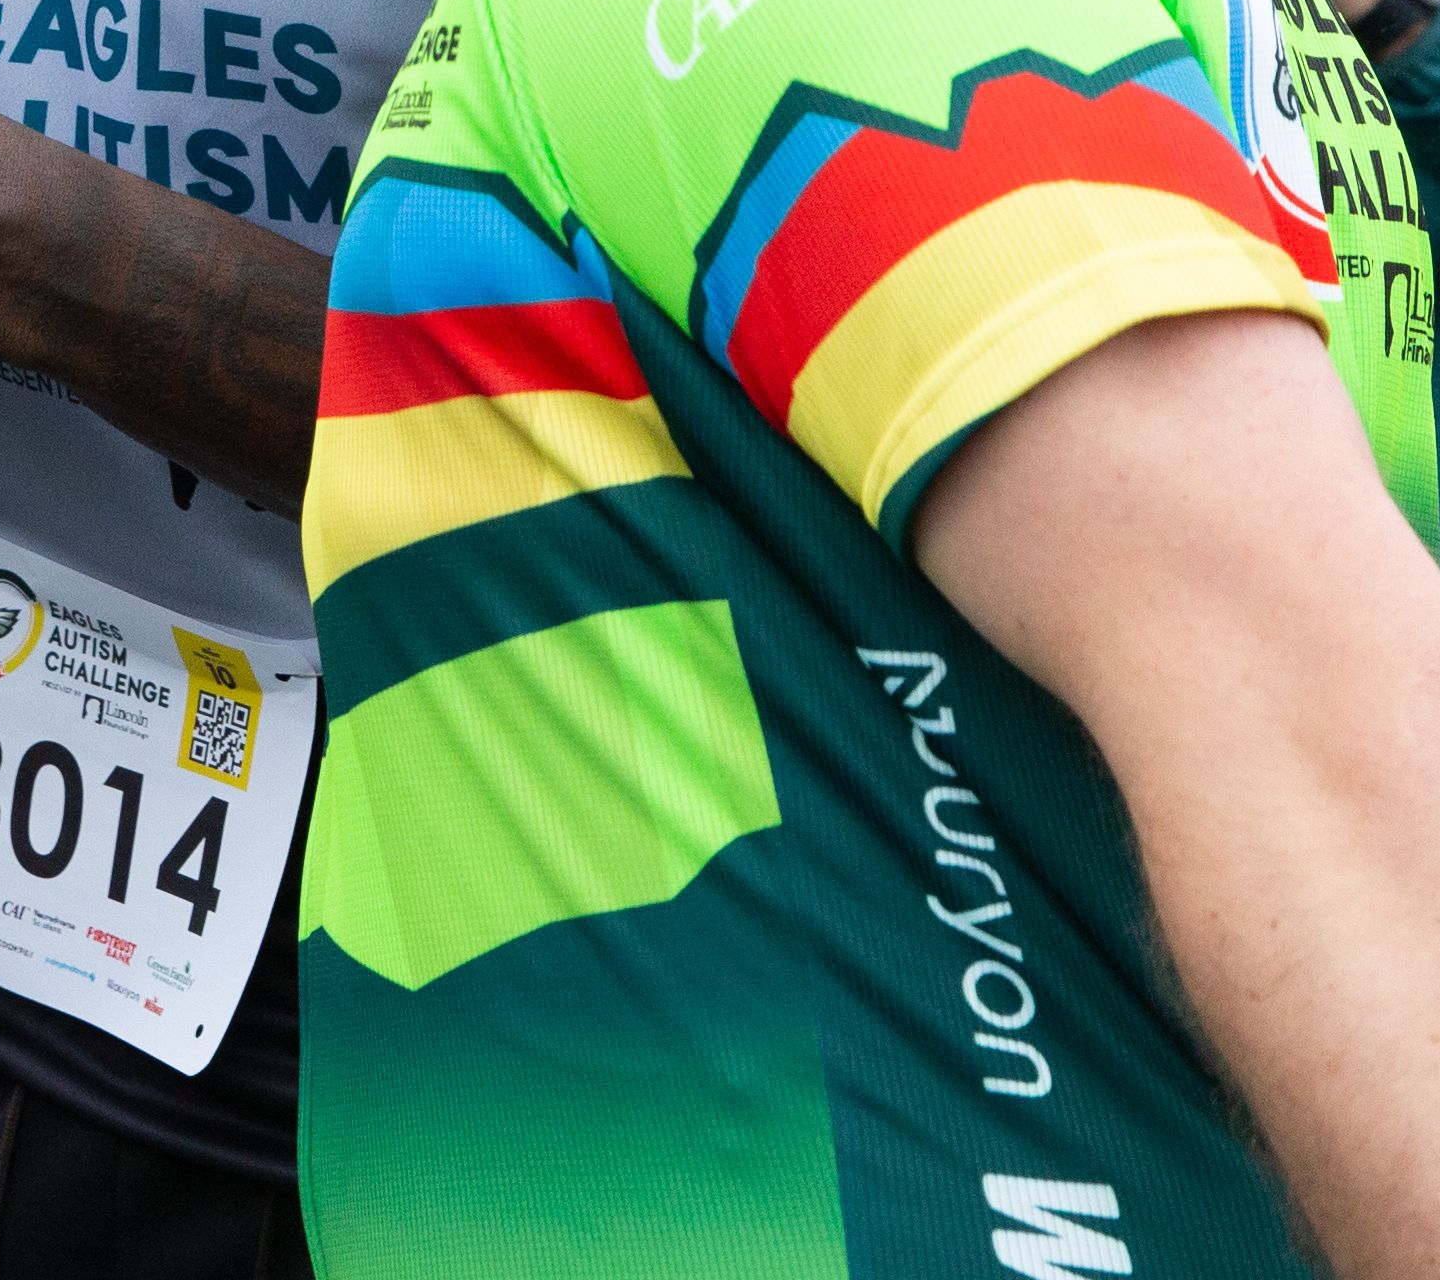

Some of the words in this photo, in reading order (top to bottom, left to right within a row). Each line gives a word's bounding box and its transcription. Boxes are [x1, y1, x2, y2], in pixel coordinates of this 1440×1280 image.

[48, 600, 124, 641] EAGLES
[48, 624, 128, 667] AUTISM
[44, 650, 171, 709] CHALLENGE
[105, 699, 150, 728] Lincoln
[1, 900, 28, 921] CAI
